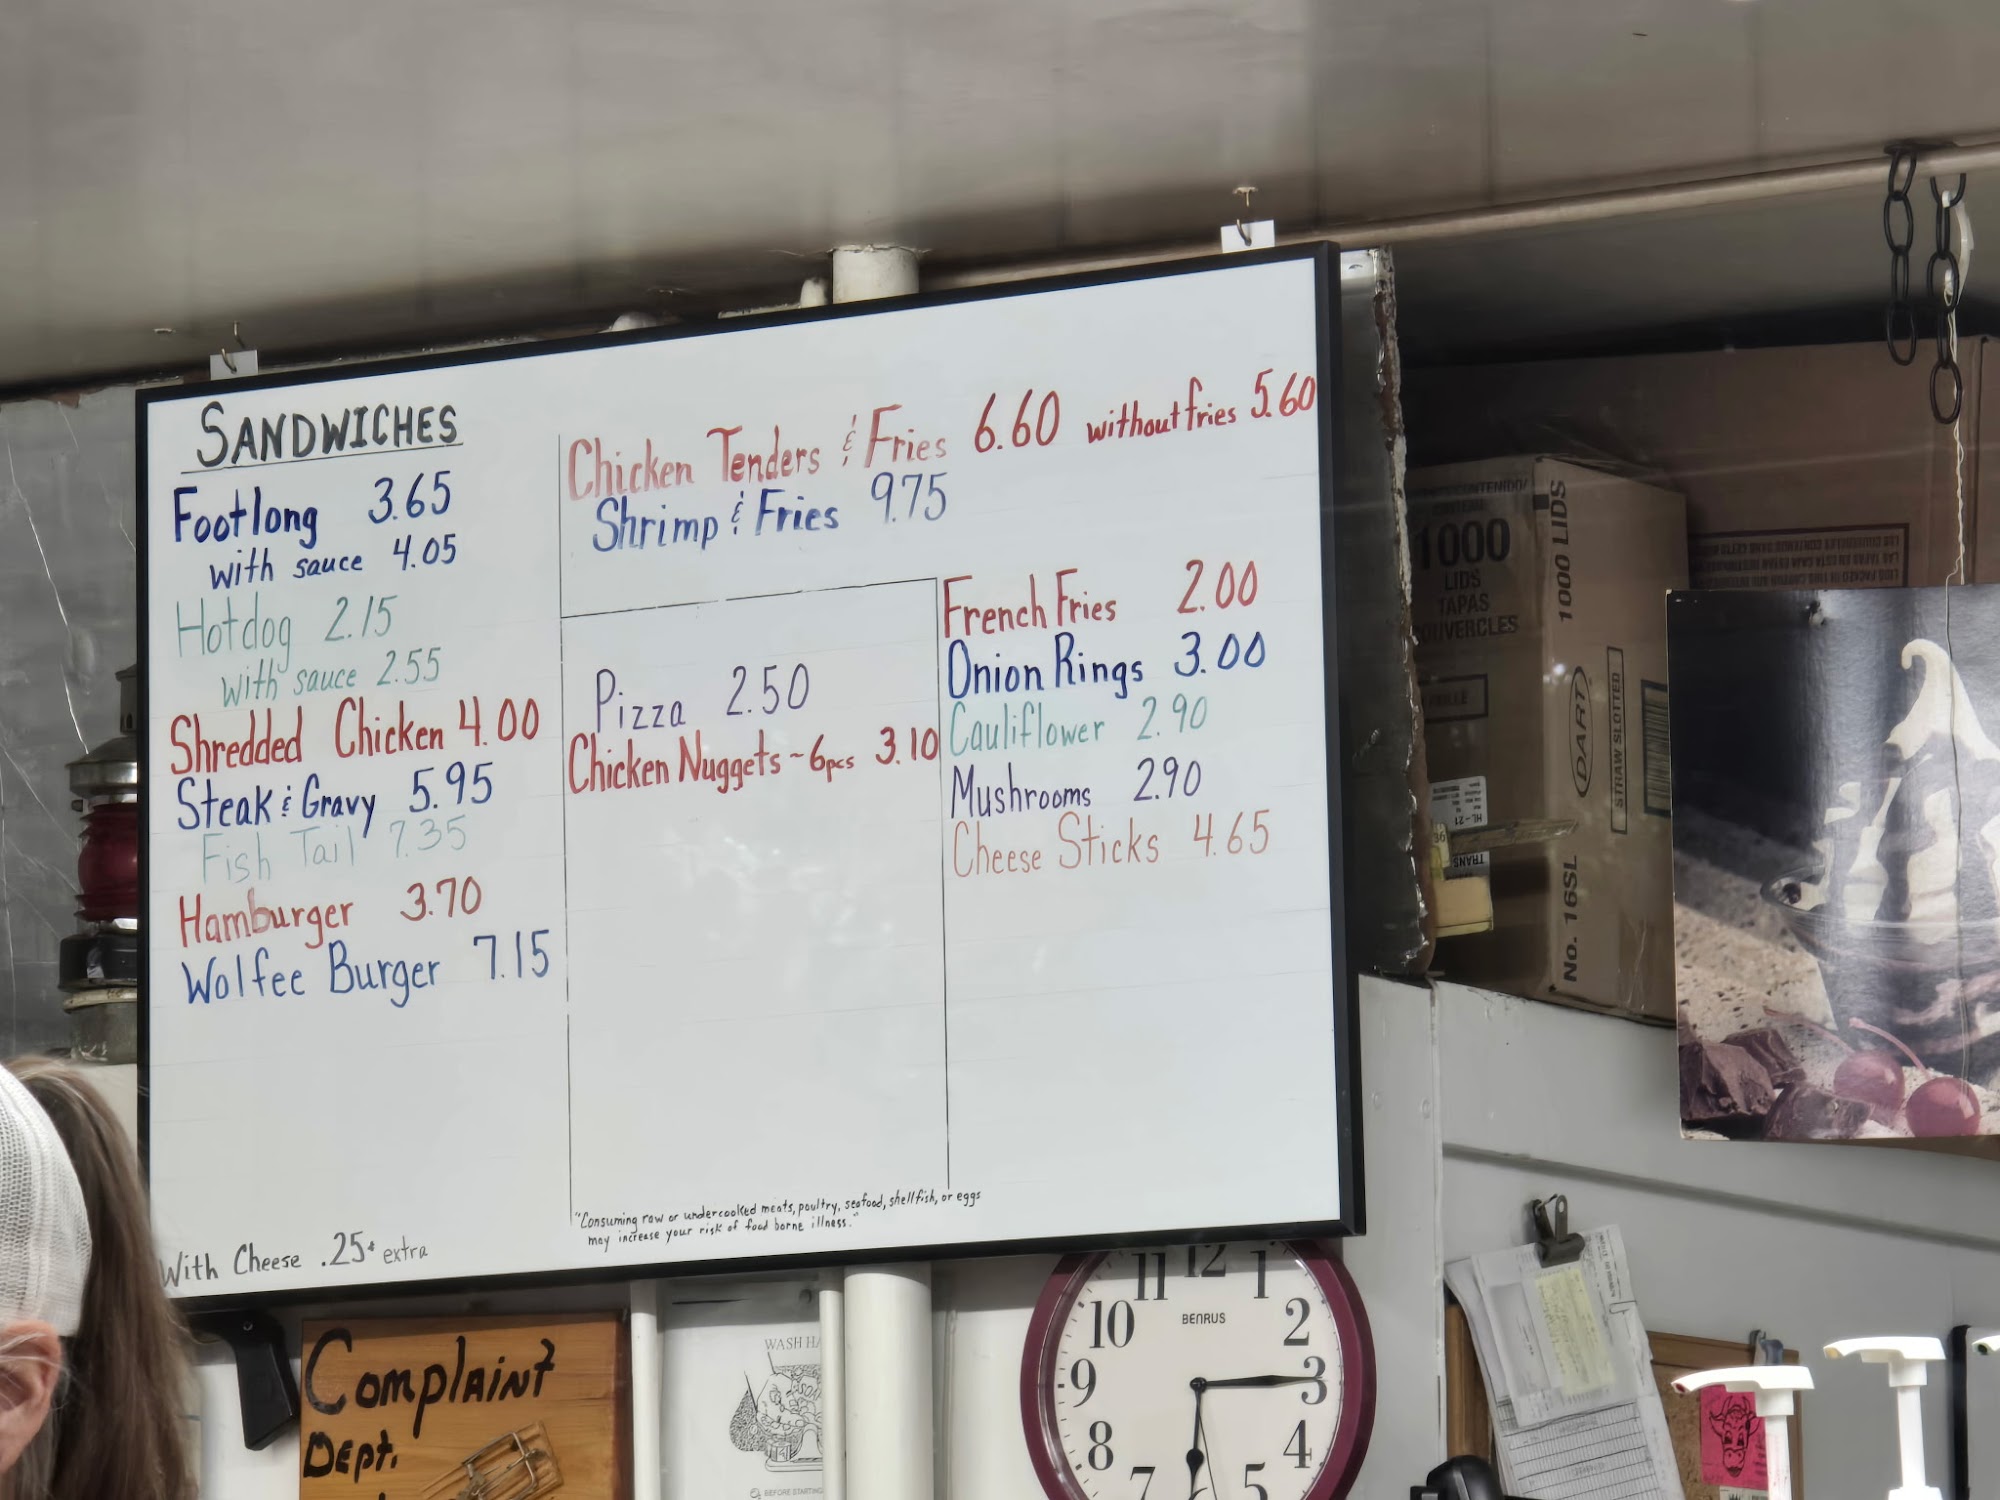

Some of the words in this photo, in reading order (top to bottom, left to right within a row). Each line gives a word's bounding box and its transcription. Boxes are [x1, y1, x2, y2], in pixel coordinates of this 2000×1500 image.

[197, 401, 459, 468] SANDWICHES
[568, 437, 694, 501] Chicken
[706, 425, 820, 483] Tenders
[864, 404, 947, 469] Fries
[974, 389, 1060, 453] 6.60
[1250, 368, 1316, 419] 5.60
[173, 486, 318, 549] Footlong
[368, 471, 452, 524] 3.65
[593, 495, 719, 552] Shrimp
[755, 488, 839, 536] Fries
[871, 471, 947, 523] 9.75
[1551, 480, 1568, 545] LIDS
[210, 547, 274, 590] with
[293, 552, 363, 578] sauce
[394, 533, 457, 571] 4.05
[1417, 518, 1511, 570] 1000
[943, 573, 1047, 639] French
[1056, 567, 1117, 626] Fries
[1177, 559, 1258, 614] 2.00
[1439, 593, 1490, 615] TAPAS
[1444, 569, 1481, 590] LIDS
[1555, 554, 1573, 622] 1000
[176, 591, 292, 673] Hotdog
[325, 595, 398, 643] 2.15
[1416, 615, 1519, 643] OUVERCLES
[222, 658, 278, 707] with
[293, 667, 356, 695] sauce
[377, 647, 441, 686] 2.55
[947, 638, 1045, 699] Onion
[1055, 631, 1143, 699] Rings
[1174, 631, 1266, 677] 3.00
[596, 668, 686, 733] Pizza
[726, 663, 810, 716] 2.50
[949, 701, 1105, 756] Cauliflower
[1136, 693, 1208, 741] 2.90
[1612, 672, 1622, 745] SLOTTED
[170, 705, 303, 775] Shredded
[334, 696, 444, 759] Chicken
[459, 696, 540, 747] 4.00
[568, 732, 670, 794] Chicken
[678, 728, 781, 794] Nuggets
[809, 734, 854, 783] 6pcs
[875, 726, 939, 766] 3.10
[1575, 682, 1587, 782] DART
[177, 776, 272, 830] Steak
[302, 773, 376, 838] Gravy
[409, 761, 493, 813] 5.95
[951, 762, 1091, 819] Mushrooms
[1133, 756, 1202, 802] 2.90
[1613, 748, 1623, 808] STRAW
[201, 832, 272, 884] Fish
[290, 826, 355, 867] Tail
[389, 815, 468, 859] 7.35
[953, 820, 1042, 877] Cheese
[1057, 811, 1159, 869] Sticks
[1193, 809, 1271, 857] 4.65
[1453, 854, 1485, 868] TRANS
[179, 887, 354, 949] Hamburger
[400, 876, 482, 922] 3.70
[1563, 856, 1577, 922] 16SL
[182, 947, 306, 1004] Wolfee
[328, 940, 441, 1008] Burger
[473, 929, 550, 980] 7.15
[1563, 938, 1577, 982] No.
[588, 1233, 610, 1253] may
[618, 1230, 660, 1243] increase
[666, 1227, 693, 1246] your
[700, 1222, 722, 1235] risk
[727, 1219, 738, 1232] of
[744, 1218, 768, 1231] food
[774, 1217, 804, 1232] borne
[668, 1213, 679, 1223] or
[684, 1203, 757, 1221] undercooked
[761, 1199, 796, 1216] meats,
[798, 1198, 841, 1217] poultry,
[845, 1192, 886, 1211] seafood,
[889, 1189, 938, 1207] shellfish,
[941, 1192, 952, 1202] or
[956, 1190, 981, 1208] eggs
[159, 1250, 219, 1288] With
[233, 1242, 302, 1275] Cheese
[383, 1235, 428, 1264] extra
[1131, 1252, 1168, 1300] 11
[1251, 1250, 1269, 1299] 1
[764, 1336, 802, 1350] WASH
[1089, 1300, 1135, 1348] 10
[1283, 1297, 1310, 1346] 2
[1070, 1358, 1096, 1408] 9
[1301, 1356, 1327, 1405] 3
[1087, 1421, 1113, 1471] 8
[1283, 1420, 1312, 1469] 4
[1130, 1466, 1156, 1500] 7
[1244, 1462, 1268, 1500] 5
